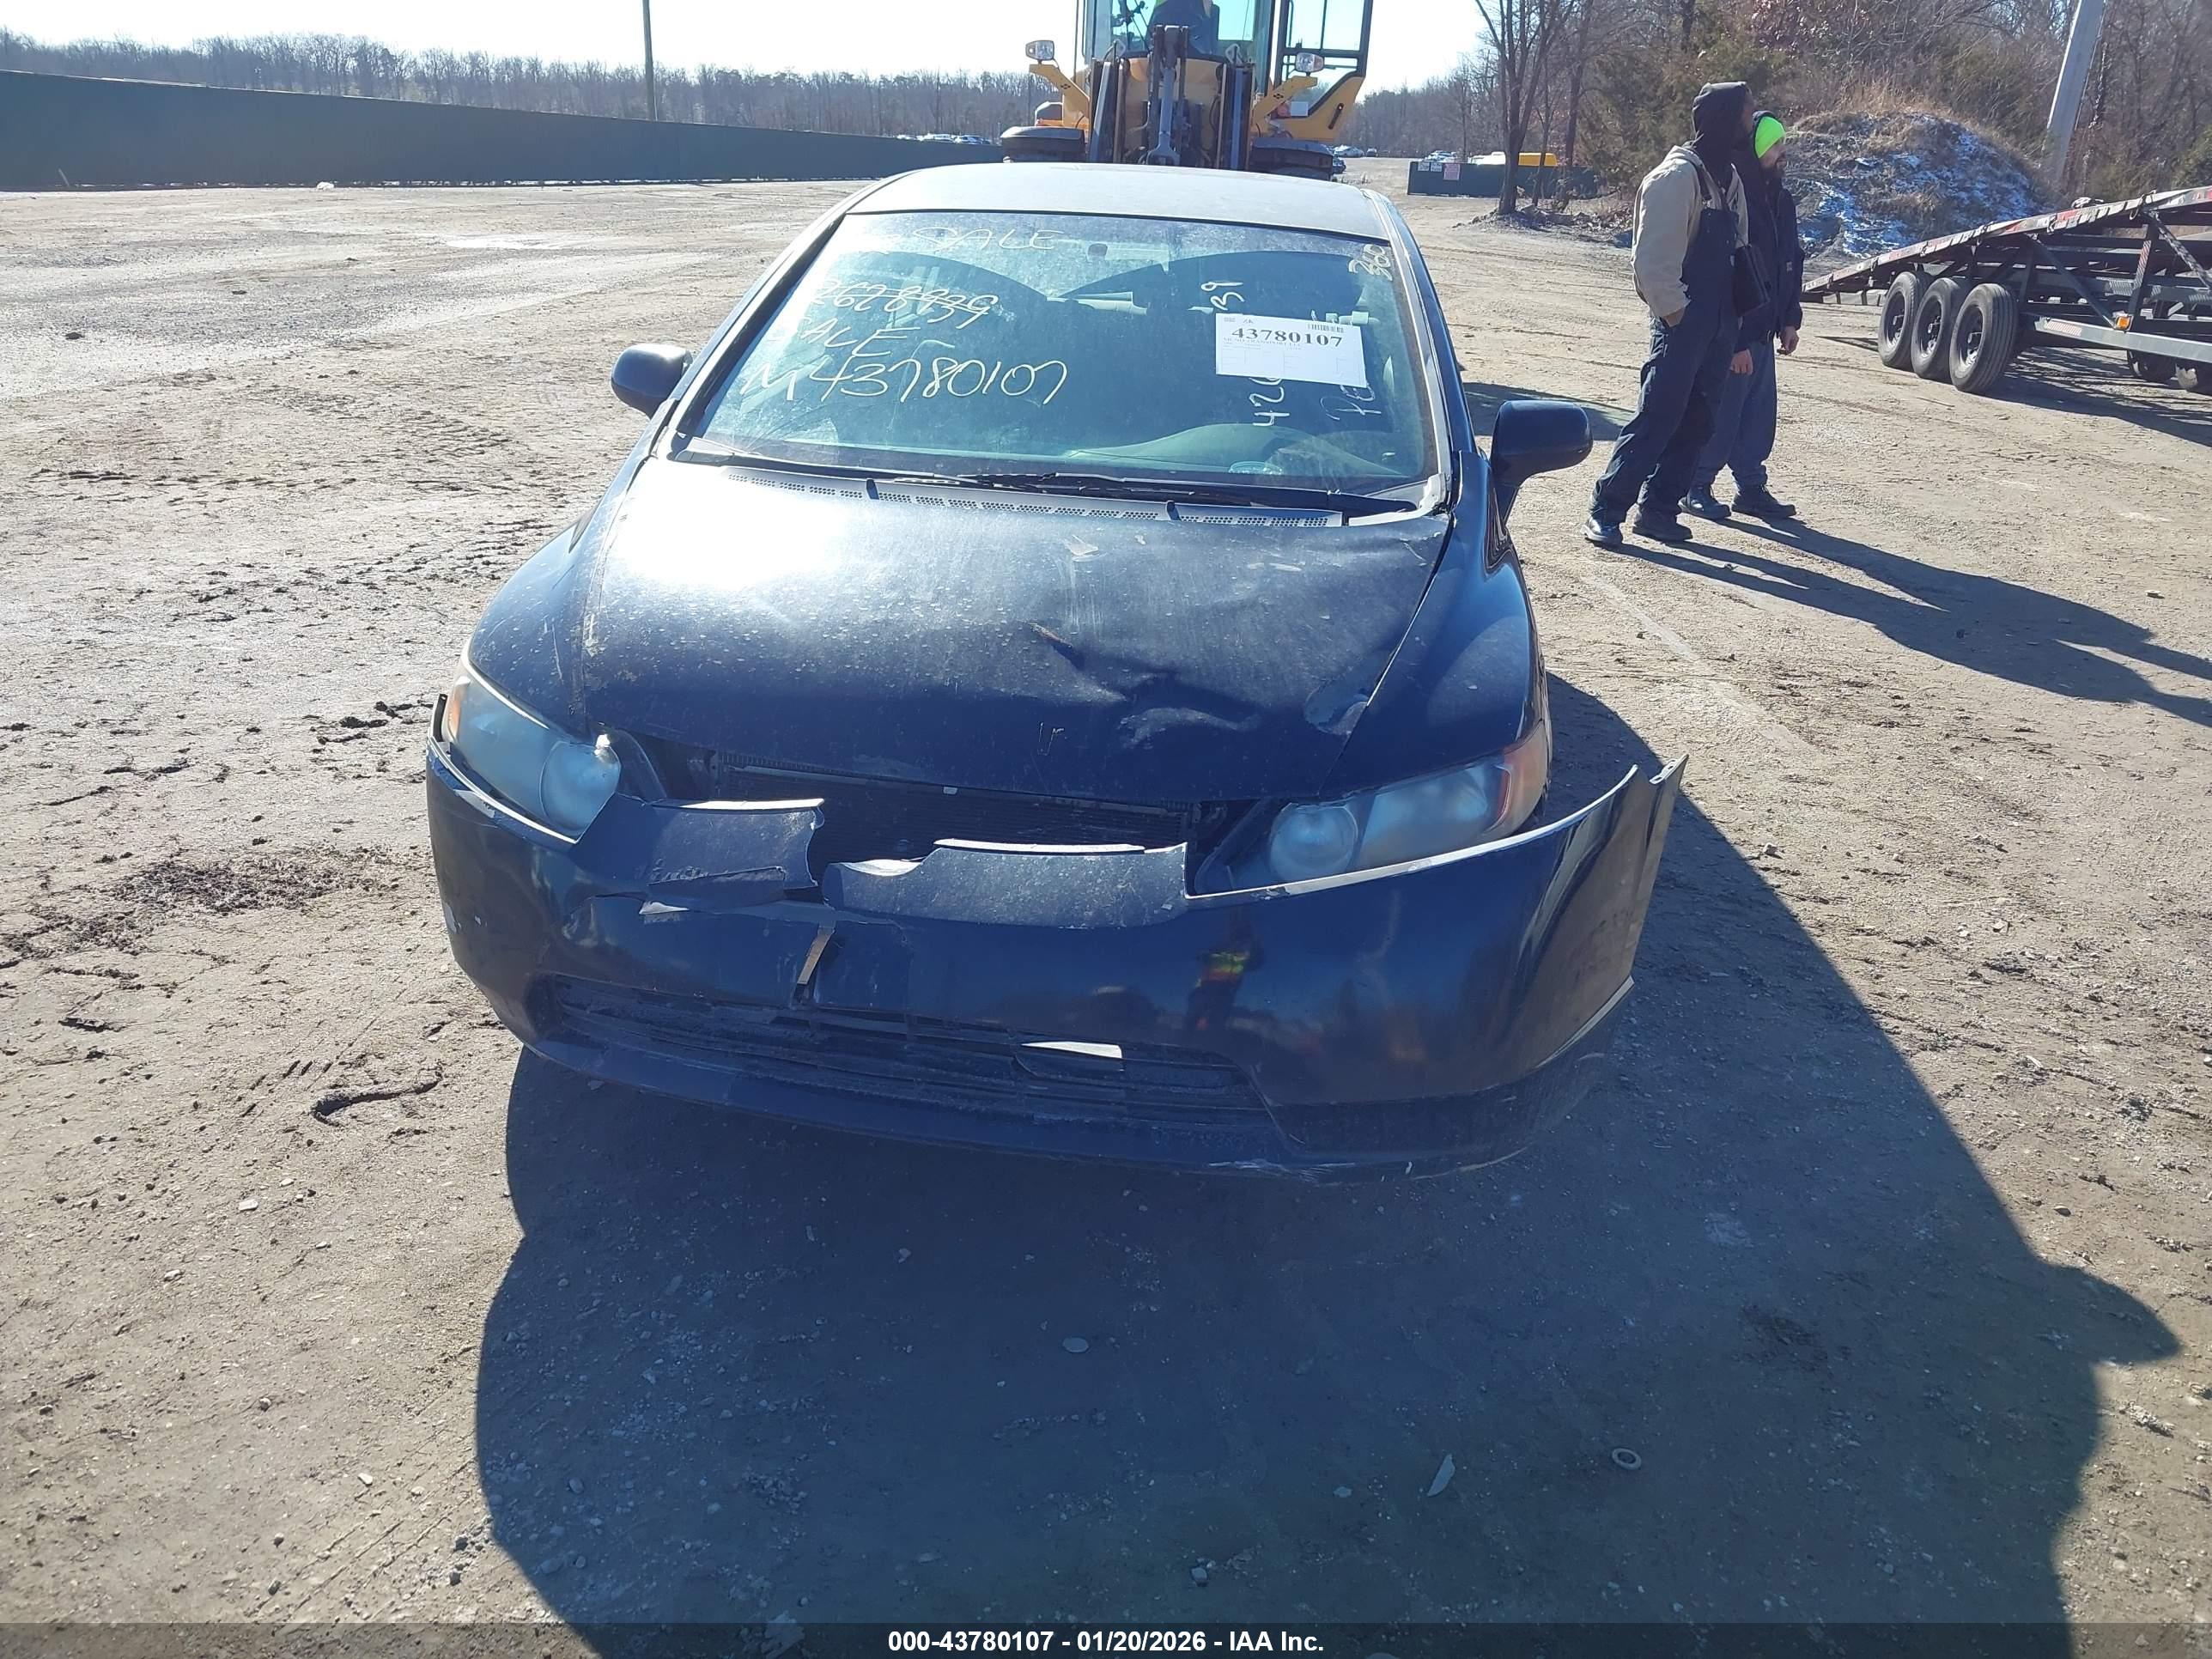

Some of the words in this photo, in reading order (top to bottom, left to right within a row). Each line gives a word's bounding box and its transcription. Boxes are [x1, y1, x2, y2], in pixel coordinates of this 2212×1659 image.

[797, 317, 921, 357] ALE
[1231, 327, 1343, 348] 43780107
[809, 354, 1068, 405] 43780107
